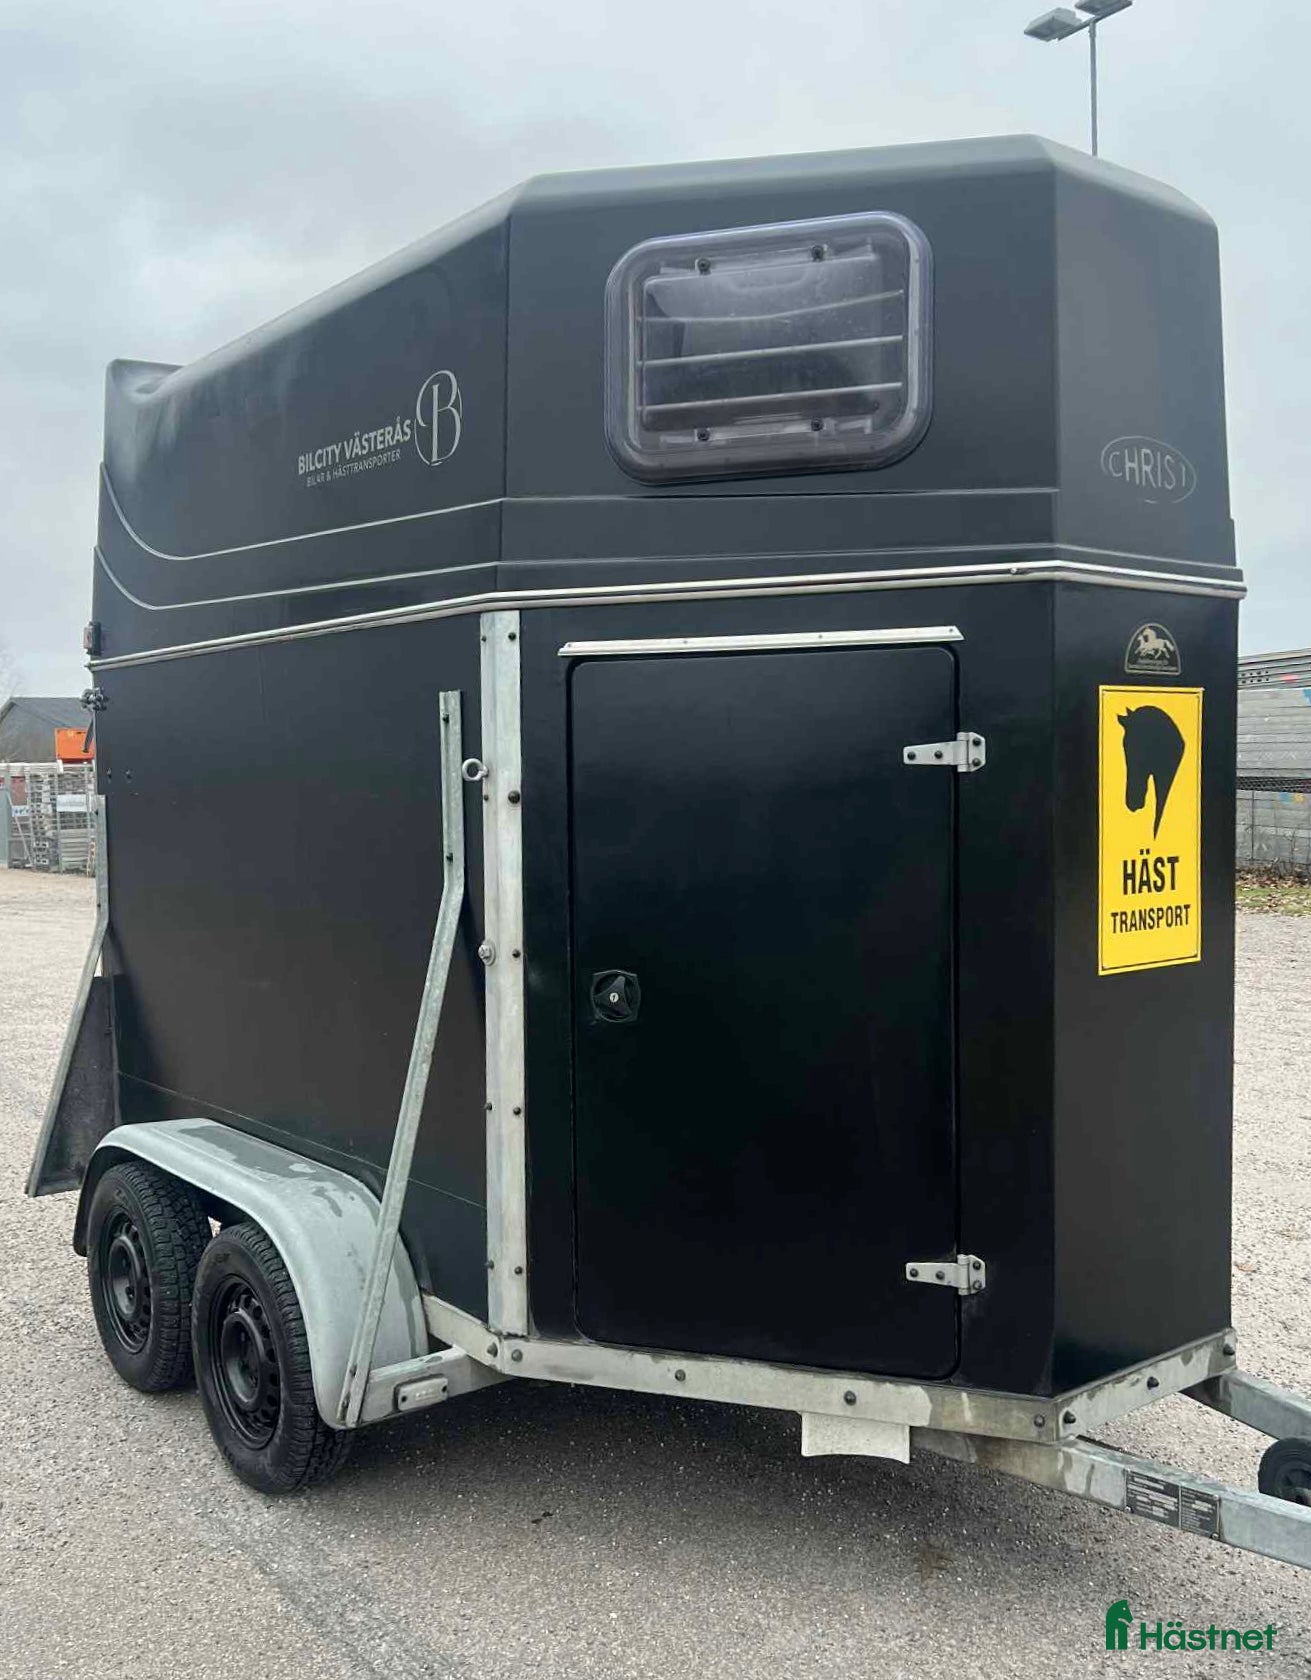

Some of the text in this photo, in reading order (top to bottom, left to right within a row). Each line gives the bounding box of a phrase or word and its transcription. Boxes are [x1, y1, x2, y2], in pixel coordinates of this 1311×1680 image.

[298, 416, 412, 476] BILCITY VÄSTERÅS
[332, 448, 402, 480] HÄSTTRANSPORTER
[1122, 848, 1180, 896] HÄST
[1111, 904, 1191, 935] TRANSPORT
